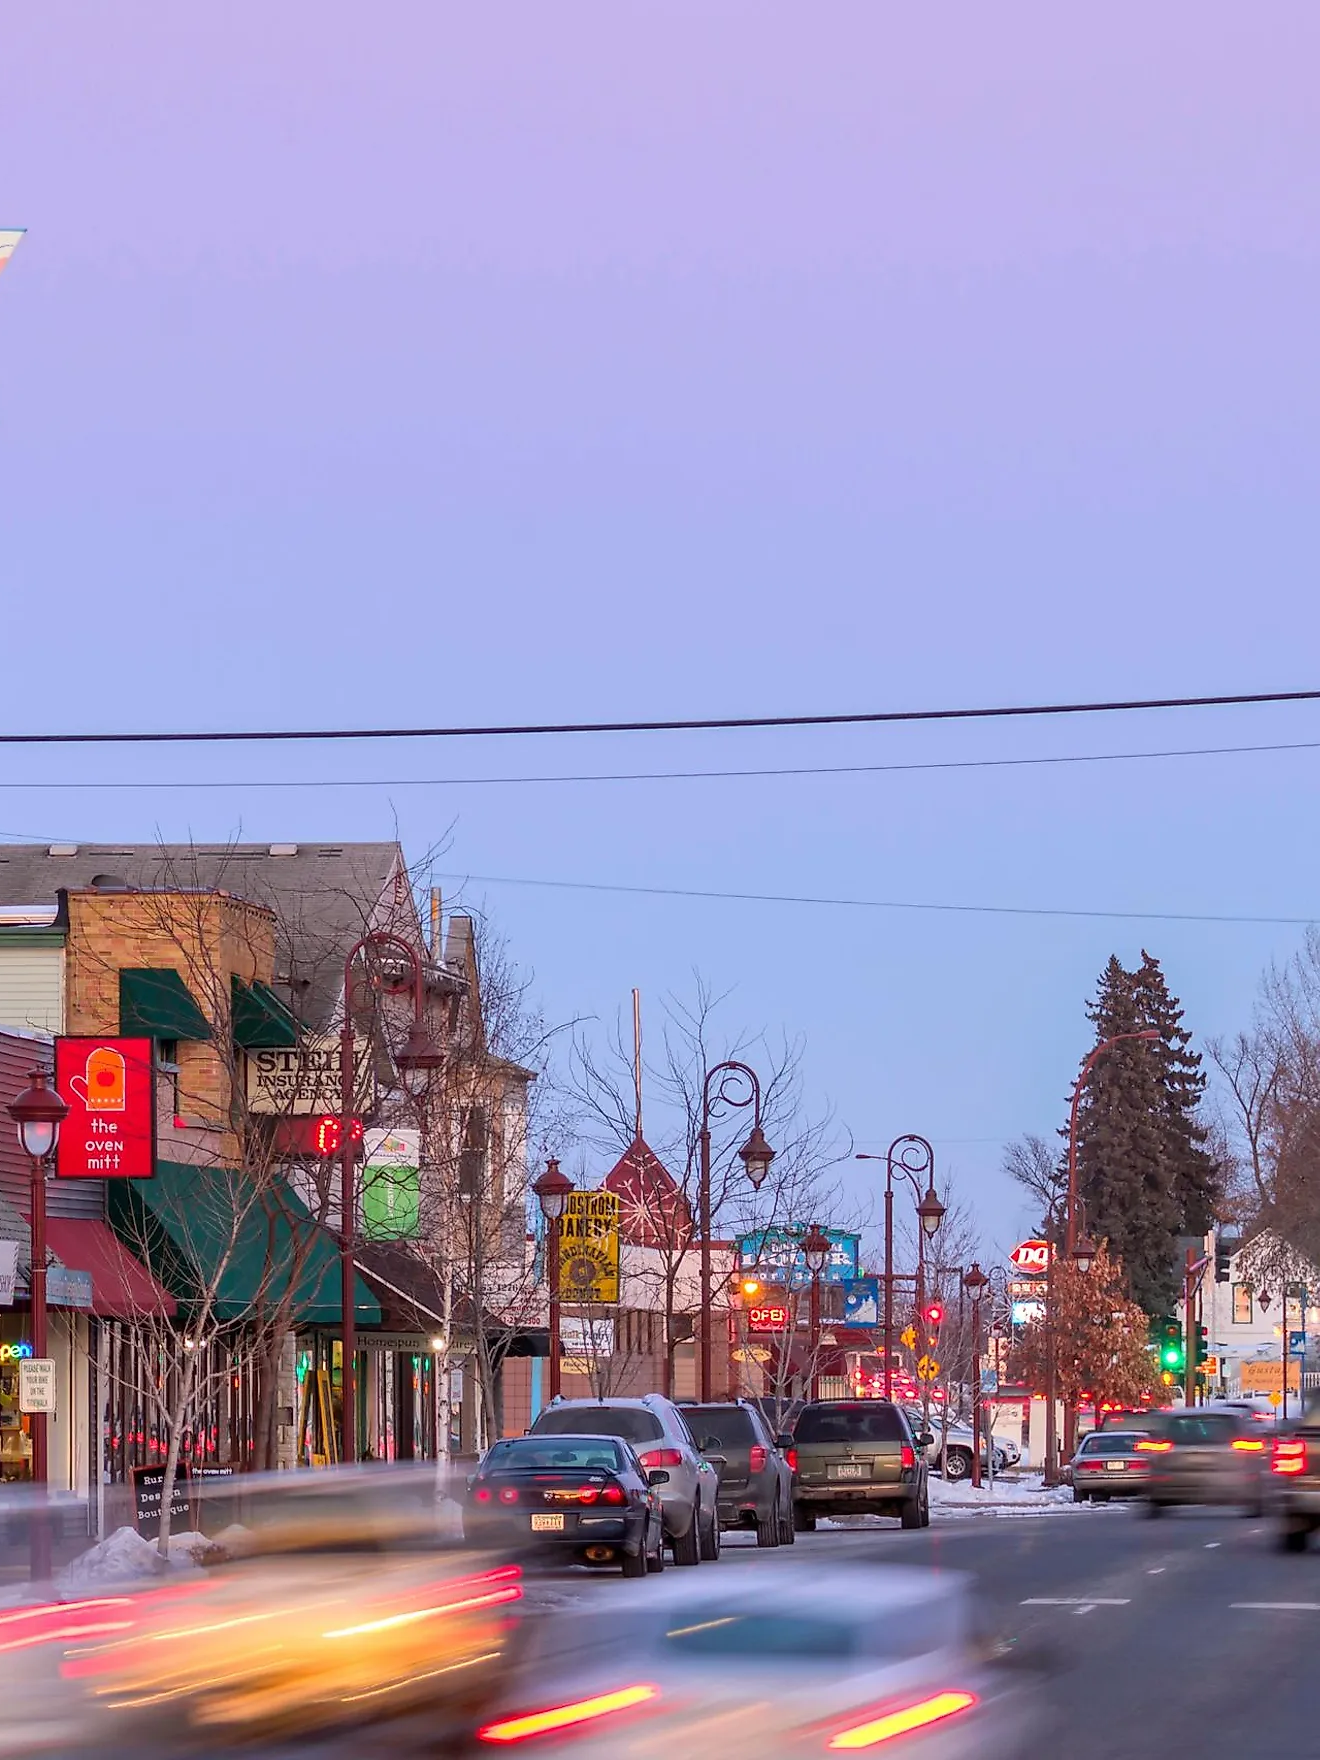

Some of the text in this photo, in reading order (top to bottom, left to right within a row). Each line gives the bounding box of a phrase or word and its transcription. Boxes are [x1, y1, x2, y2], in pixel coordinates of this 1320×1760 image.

[91, 1118, 118, 1133] the
[85, 1141, 124, 1151] oven
[87, 1154, 120, 1169] mitt
[1017, 1247, 1049, 1266] DQ
[357, 1336, 420, 1348] Homespun
[138, 1503, 190, 1520] Boutque
